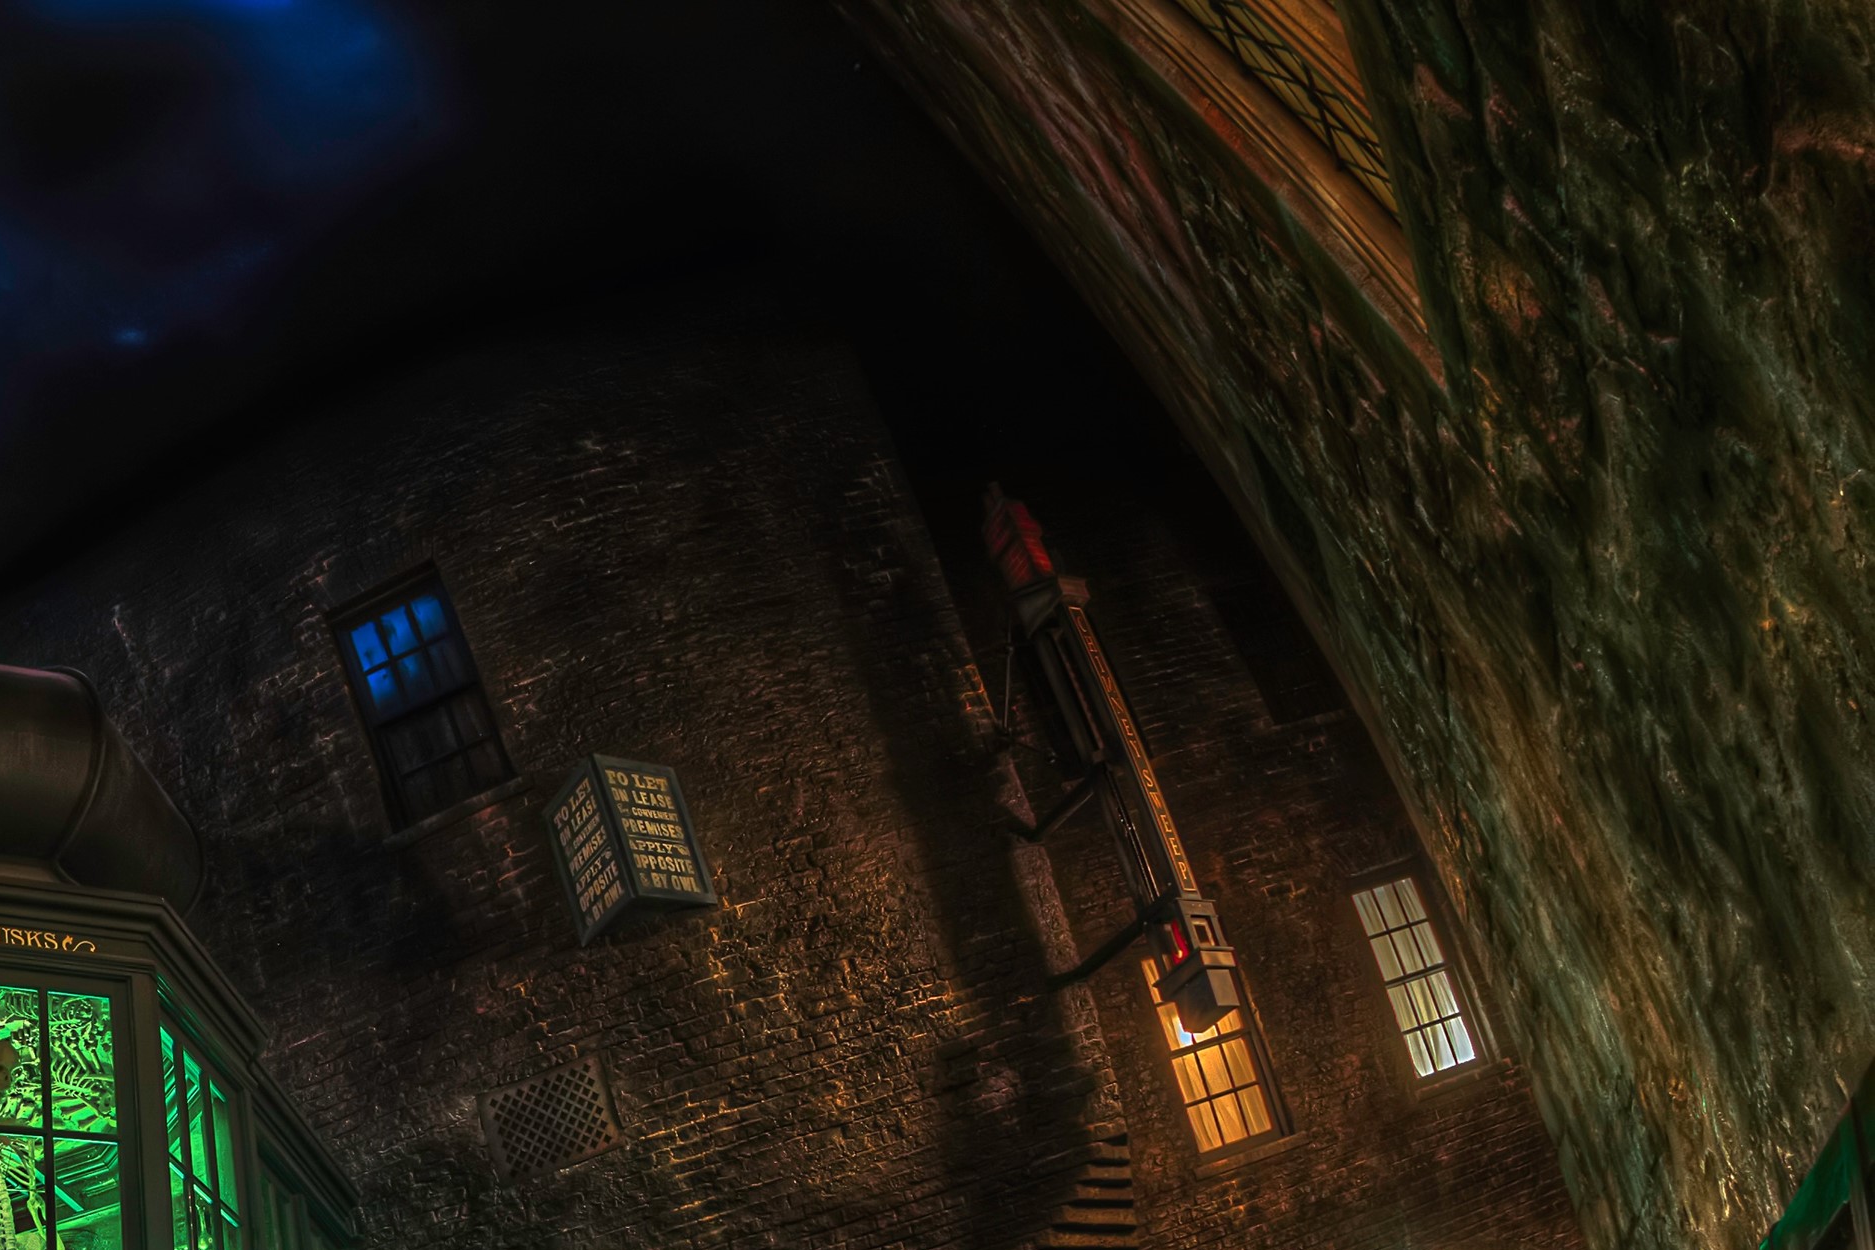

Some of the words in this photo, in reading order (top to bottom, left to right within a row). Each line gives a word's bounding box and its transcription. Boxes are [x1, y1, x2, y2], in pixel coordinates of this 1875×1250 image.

[1075, 616, 1141, 757] CHIMNEY
[1142, 768, 1188, 881] SWEEP
[605, 769, 628, 786] TO
[631, 774, 669, 791] LET
[554, 805, 569, 829] TO
[569, 778, 591, 812] LET
[611, 787, 629, 802] ON
[632, 790, 675, 810] LEASE
[571, 795, 597, 832] LEASE
[631, 807, 679, 822] CONVENIENT
[621, 818, 685, 840] PREMISES
[569, 825, 608, 877] PREMISES
[629, 839, 674, 855] APPLY
[576, 856, 603, 895] APPLY
[633, 853, 695, 875] OPPOSITE
[579, 860, 619, 913] OPPOSITE
[604, 880, 625, 910] OWL
[651, 872, 669, 889] BY
[671, 875, 702, 893] OWL
